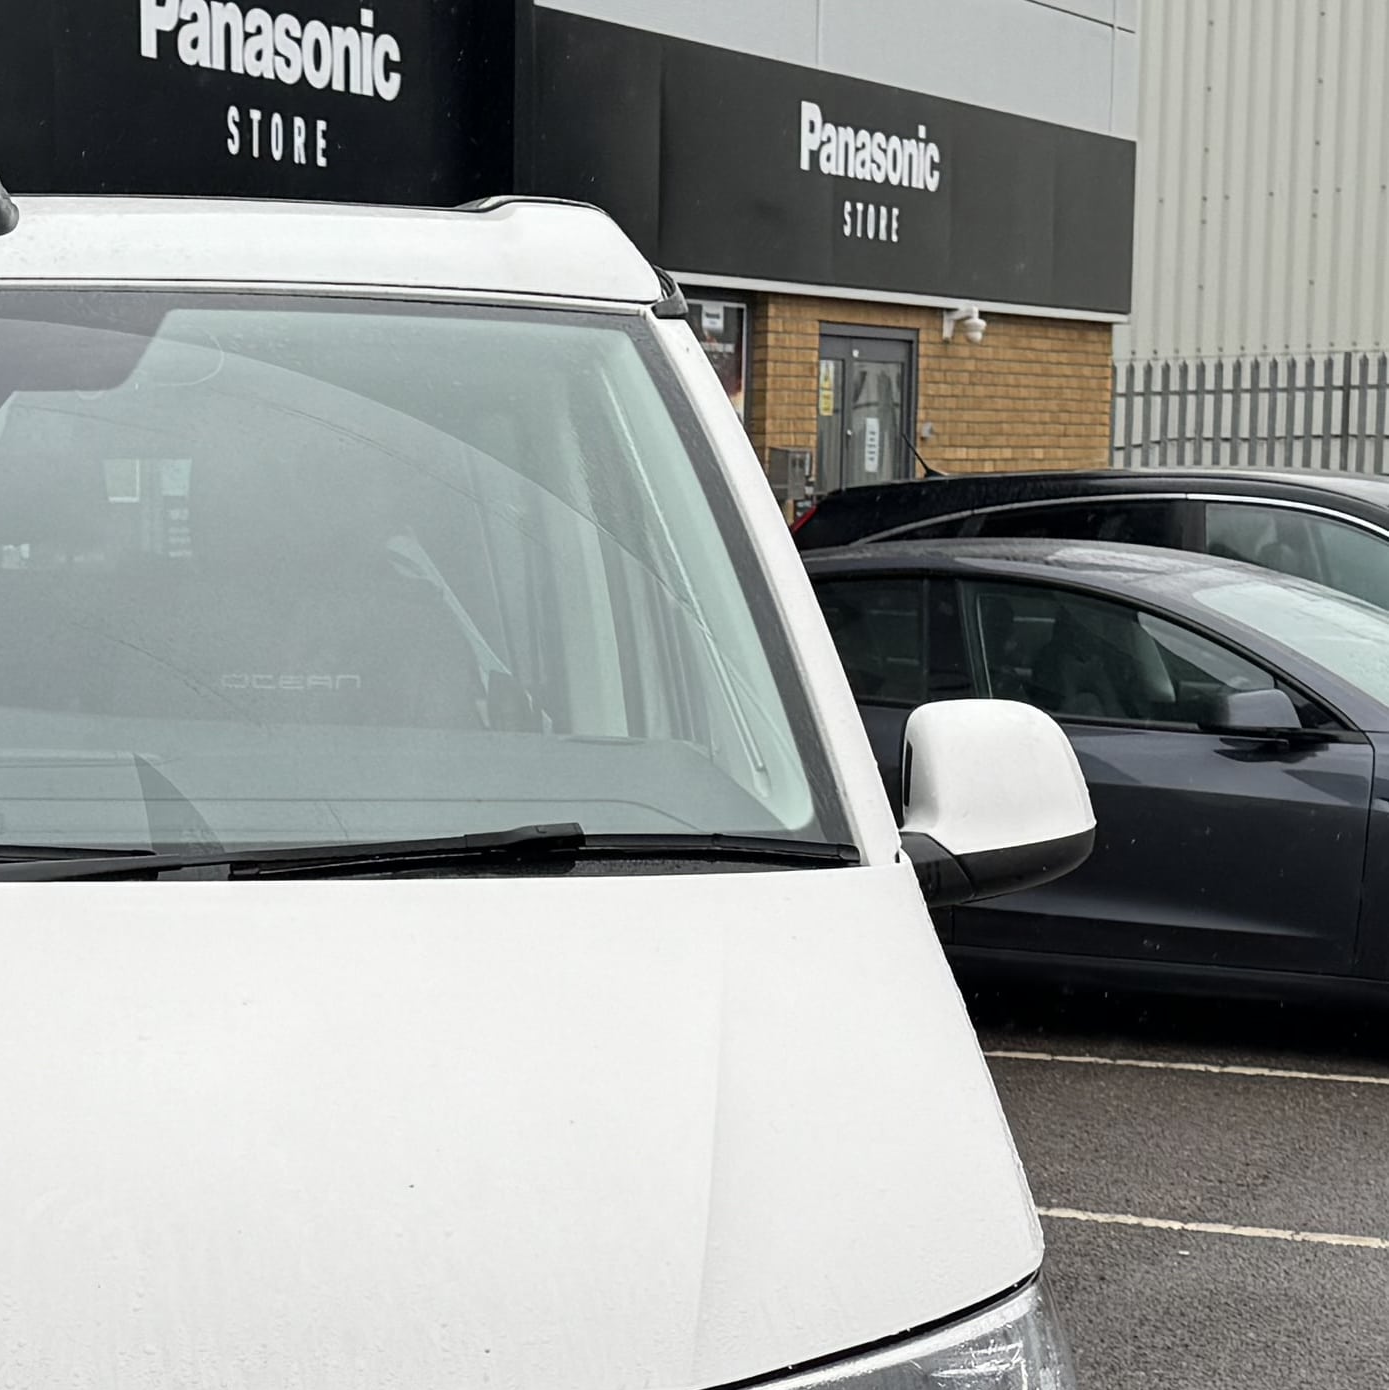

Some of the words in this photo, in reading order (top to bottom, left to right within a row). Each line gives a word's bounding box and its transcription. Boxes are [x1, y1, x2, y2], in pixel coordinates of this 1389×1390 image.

[140, 0, 401, 101] Panasonic
[227, 105, 328, 167] STORE
[800, 101, 941, 192] Panasonic
[843, 200, 900, 243] STORE
